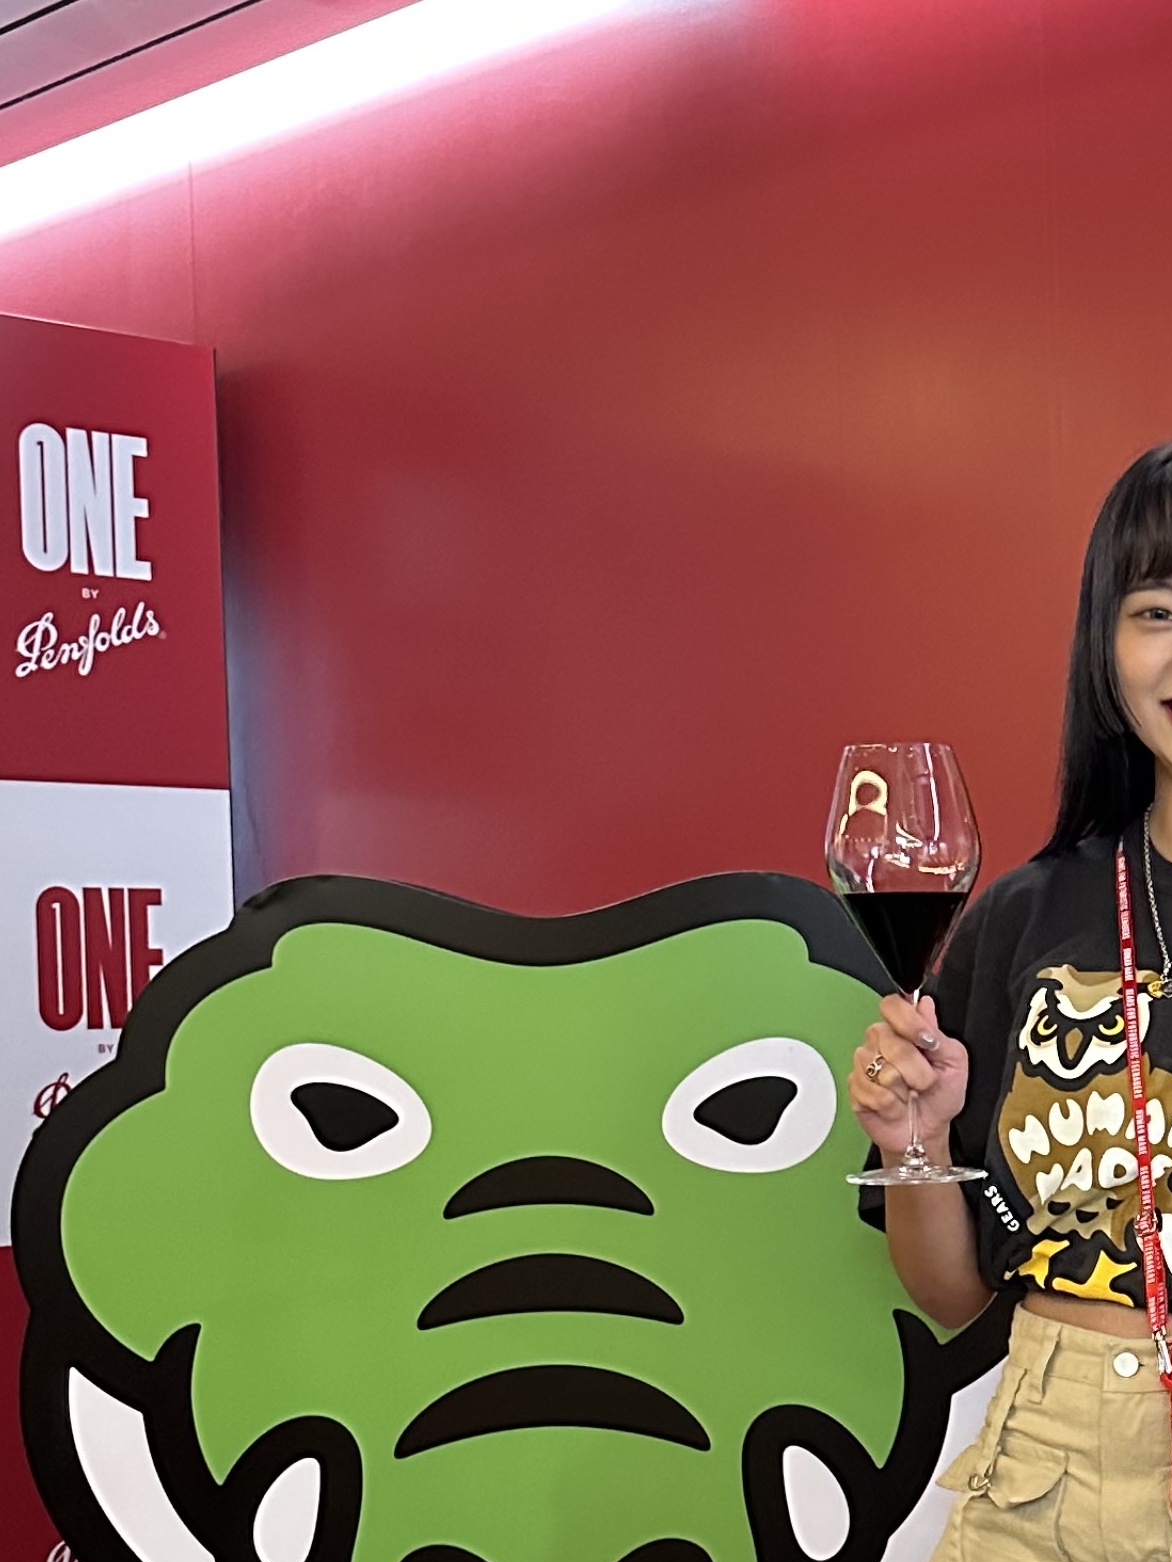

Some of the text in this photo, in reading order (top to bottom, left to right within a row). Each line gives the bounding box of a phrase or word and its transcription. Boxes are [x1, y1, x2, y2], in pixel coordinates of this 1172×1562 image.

[18, 422, 152, 581] ONE
[82, 588, 99, 599] BY
[983, 1185, 1020, 1233] GEARS
